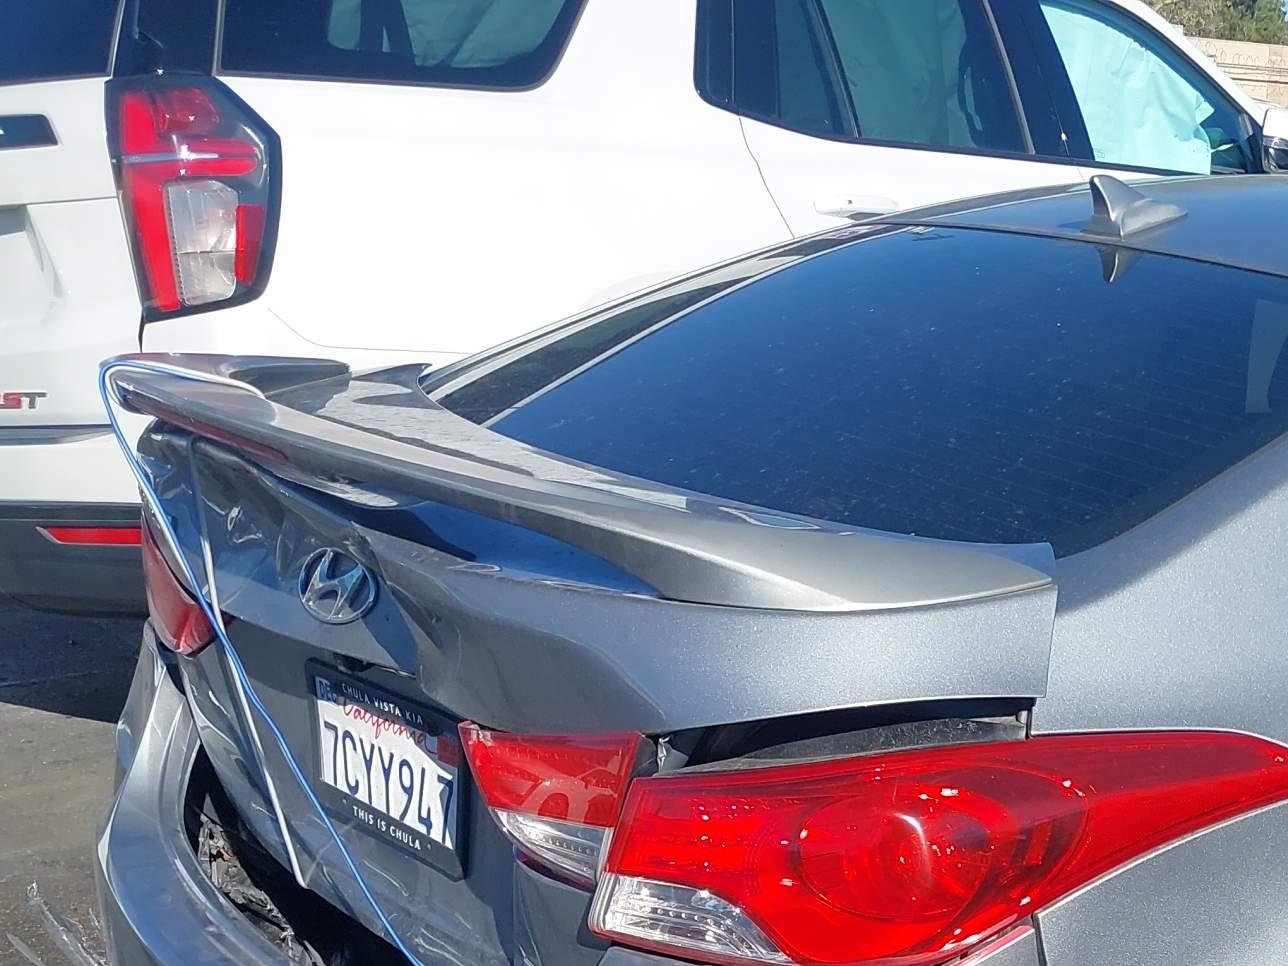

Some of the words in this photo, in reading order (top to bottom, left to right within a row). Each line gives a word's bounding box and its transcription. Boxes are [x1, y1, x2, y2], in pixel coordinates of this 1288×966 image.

[342, 683, 371, 705] CHULA
[373, 697, 402, 717] VISTA
[405, 711, 424, 726] KIA
[324, 720, 454, 845] 7CYY947
[353, 805, 374, 825] THIS
[377, 817, 387, 832] IS
[390, 826, 422, 850] CHULA
